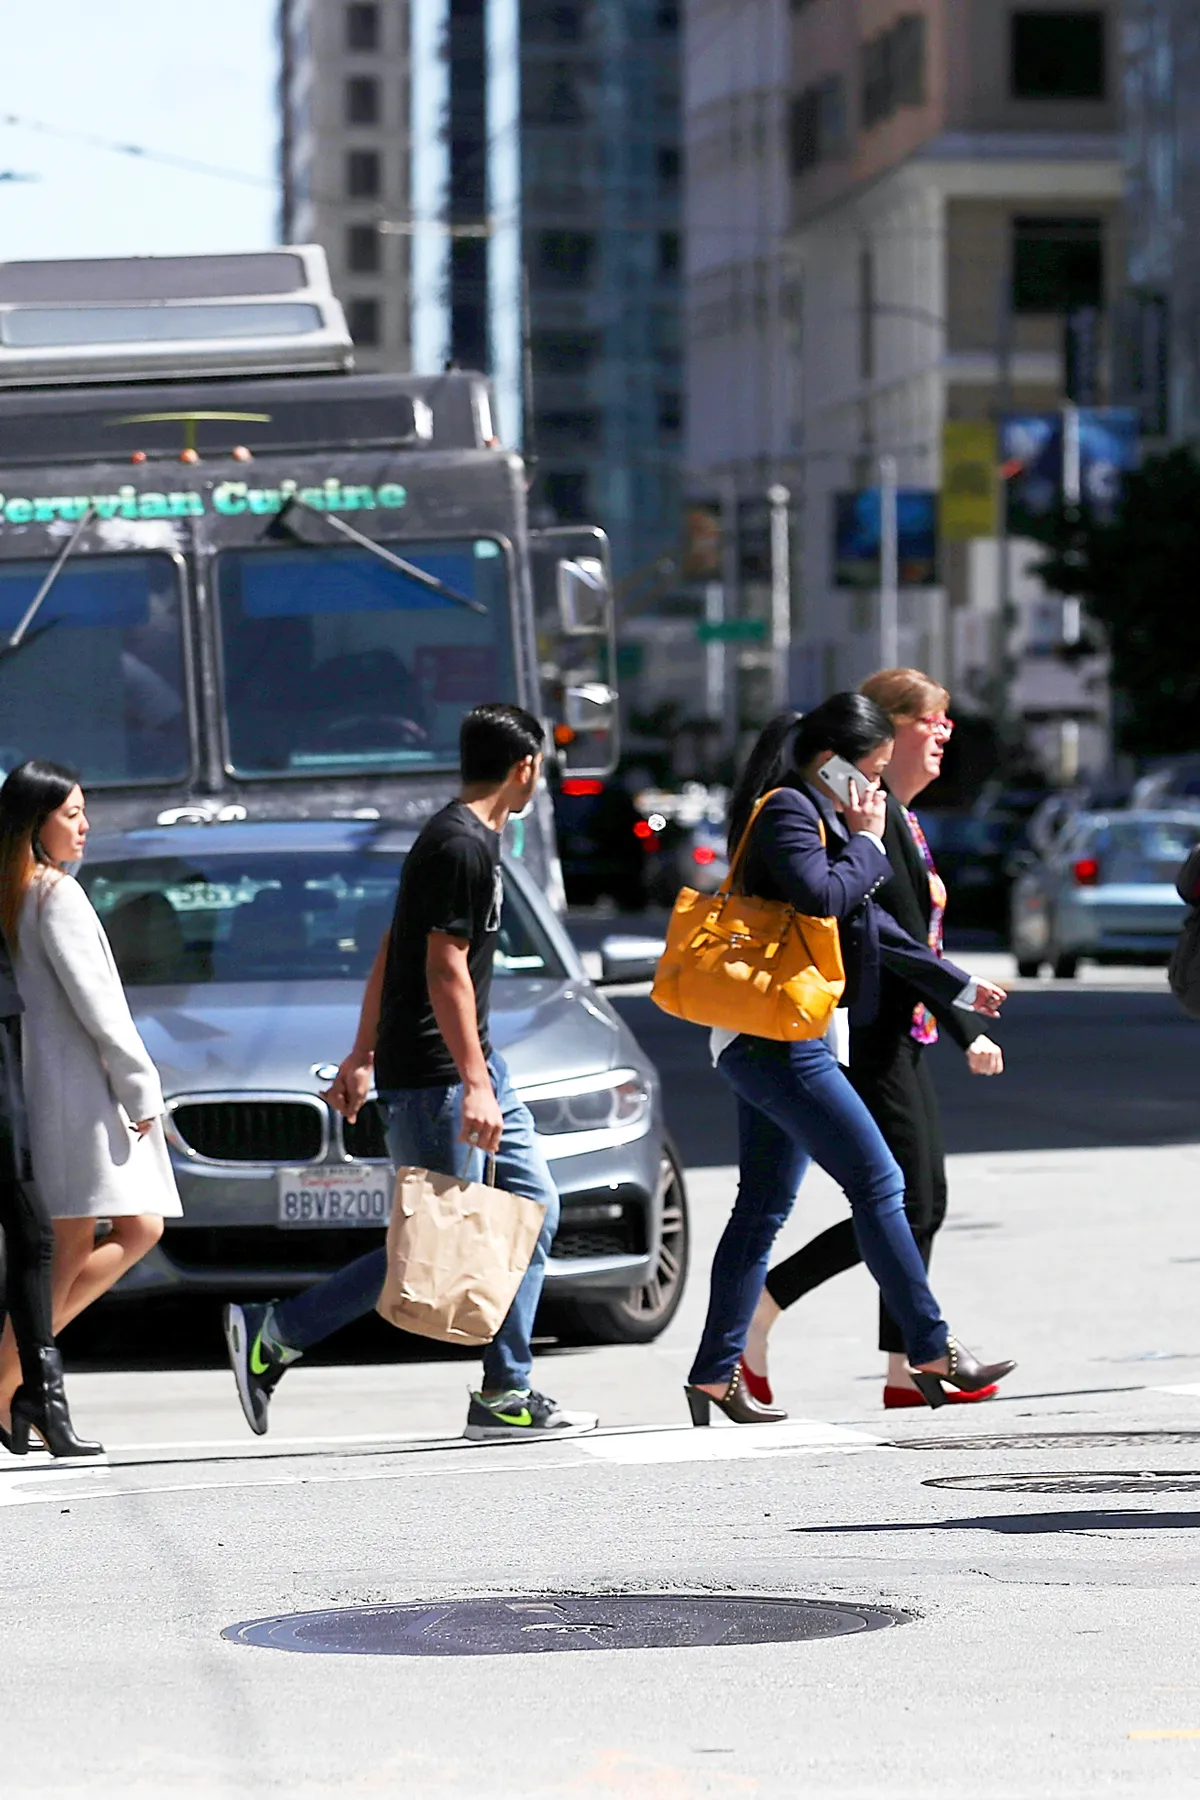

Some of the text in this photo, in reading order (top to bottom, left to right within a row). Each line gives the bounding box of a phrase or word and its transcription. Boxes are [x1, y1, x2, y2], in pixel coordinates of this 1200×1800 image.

[0, 477, 407, 524] eruvian Cuisine
[285, 1190, 385, 1218] 8BVB200
